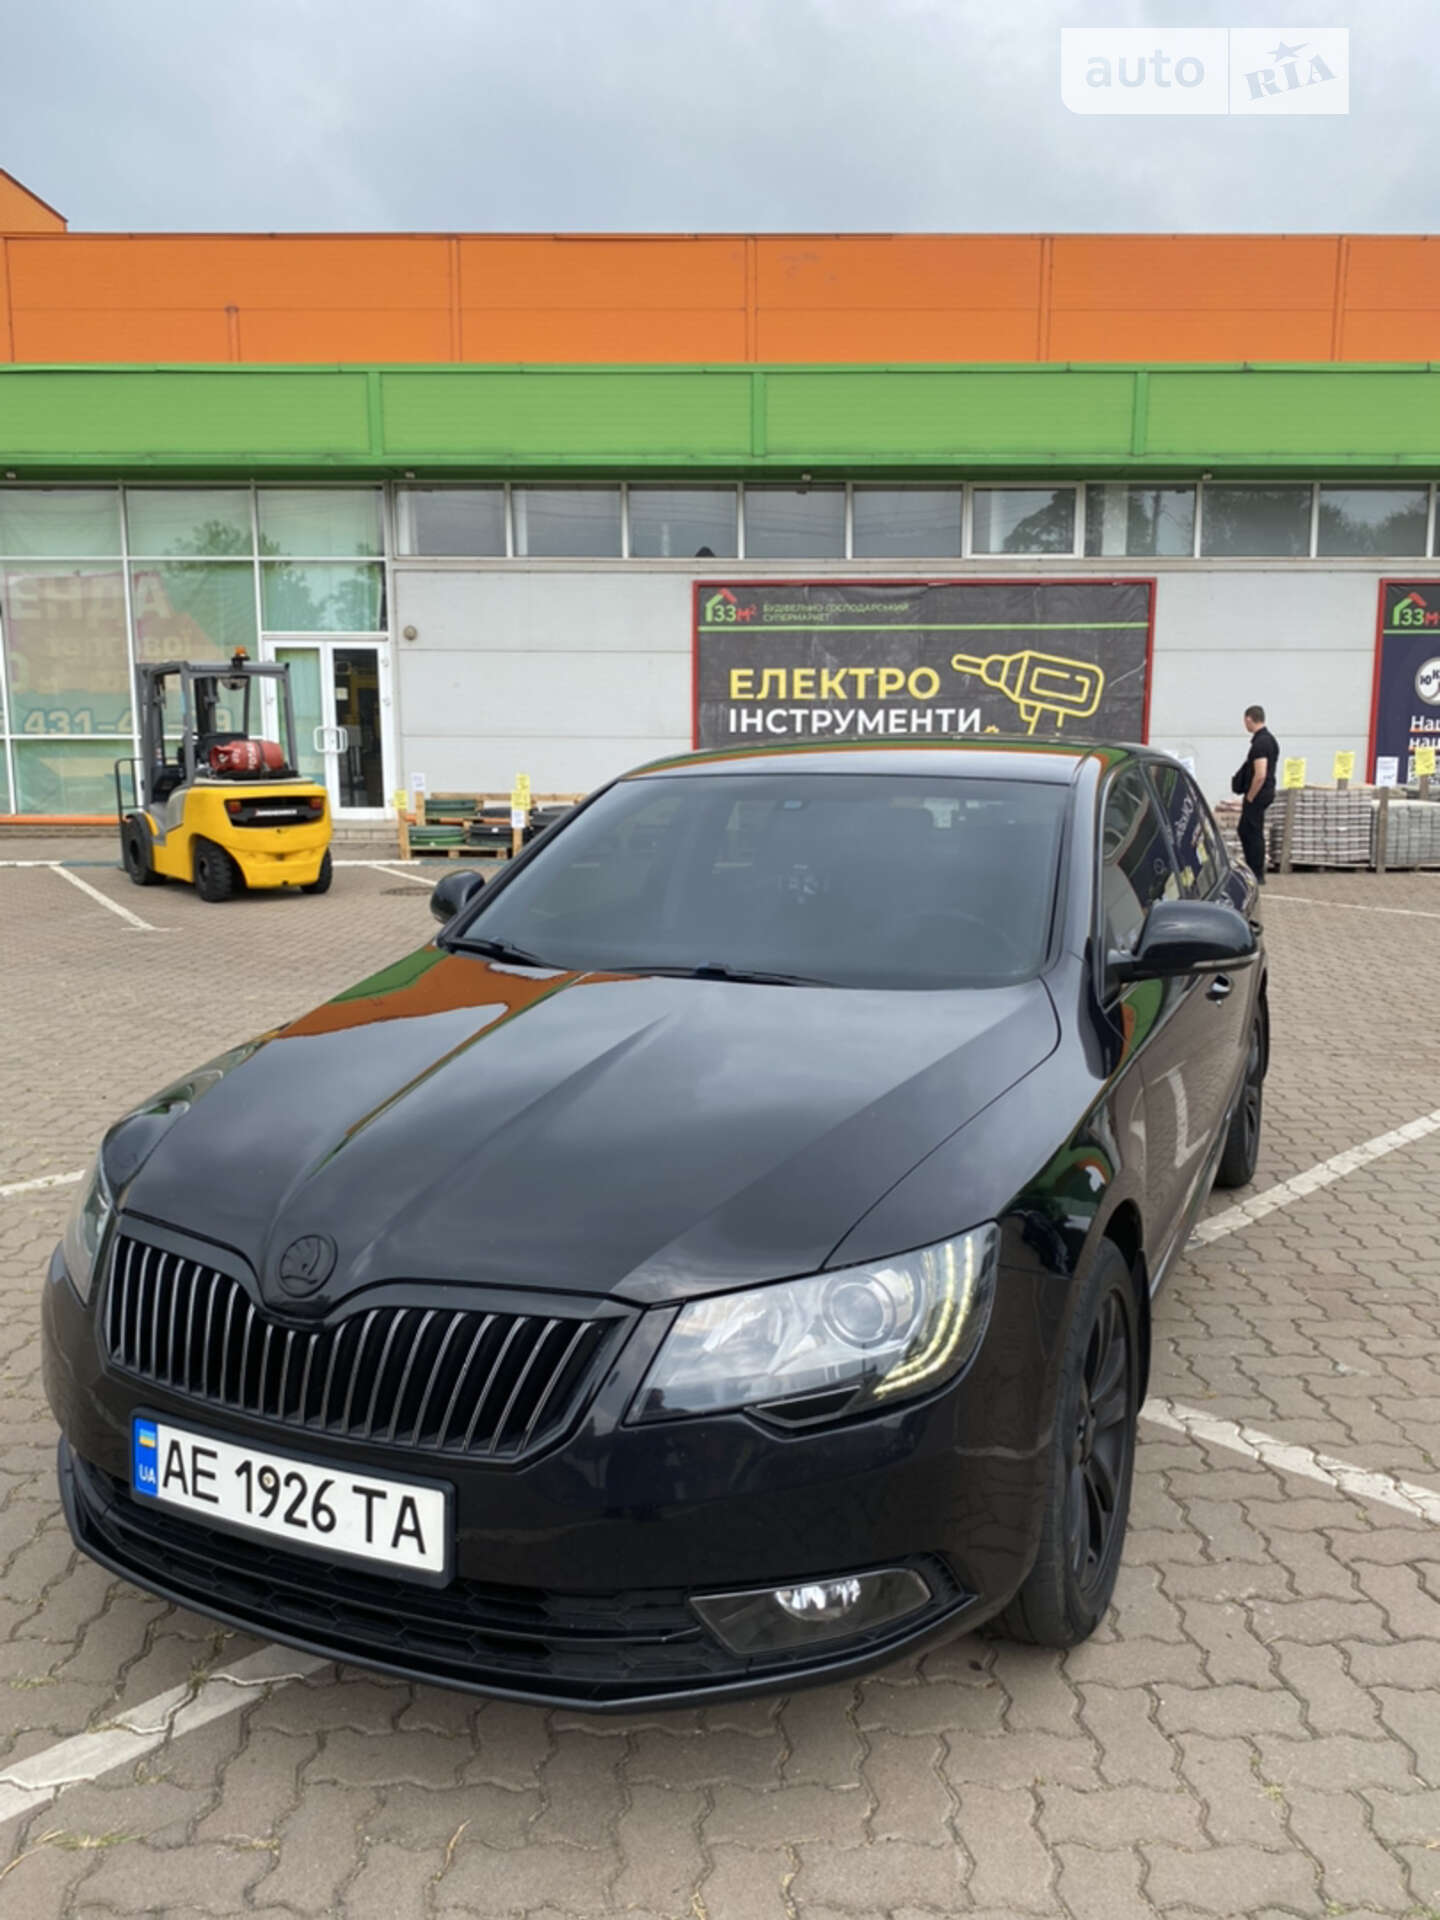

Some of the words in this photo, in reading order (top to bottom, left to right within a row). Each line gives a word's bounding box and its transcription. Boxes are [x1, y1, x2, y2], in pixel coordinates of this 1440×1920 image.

[730, 667, 940, 701] ЕЛЕКТРО
[729, 708, 982, 735] ІНСТРУМЕНТИ
[139, 1464, 157, 1485] UA
[162, 1439, 219, 1504] AE
[235, 1460, 338, 1534] 1926
[352, 1484, 427, 1555] TA
